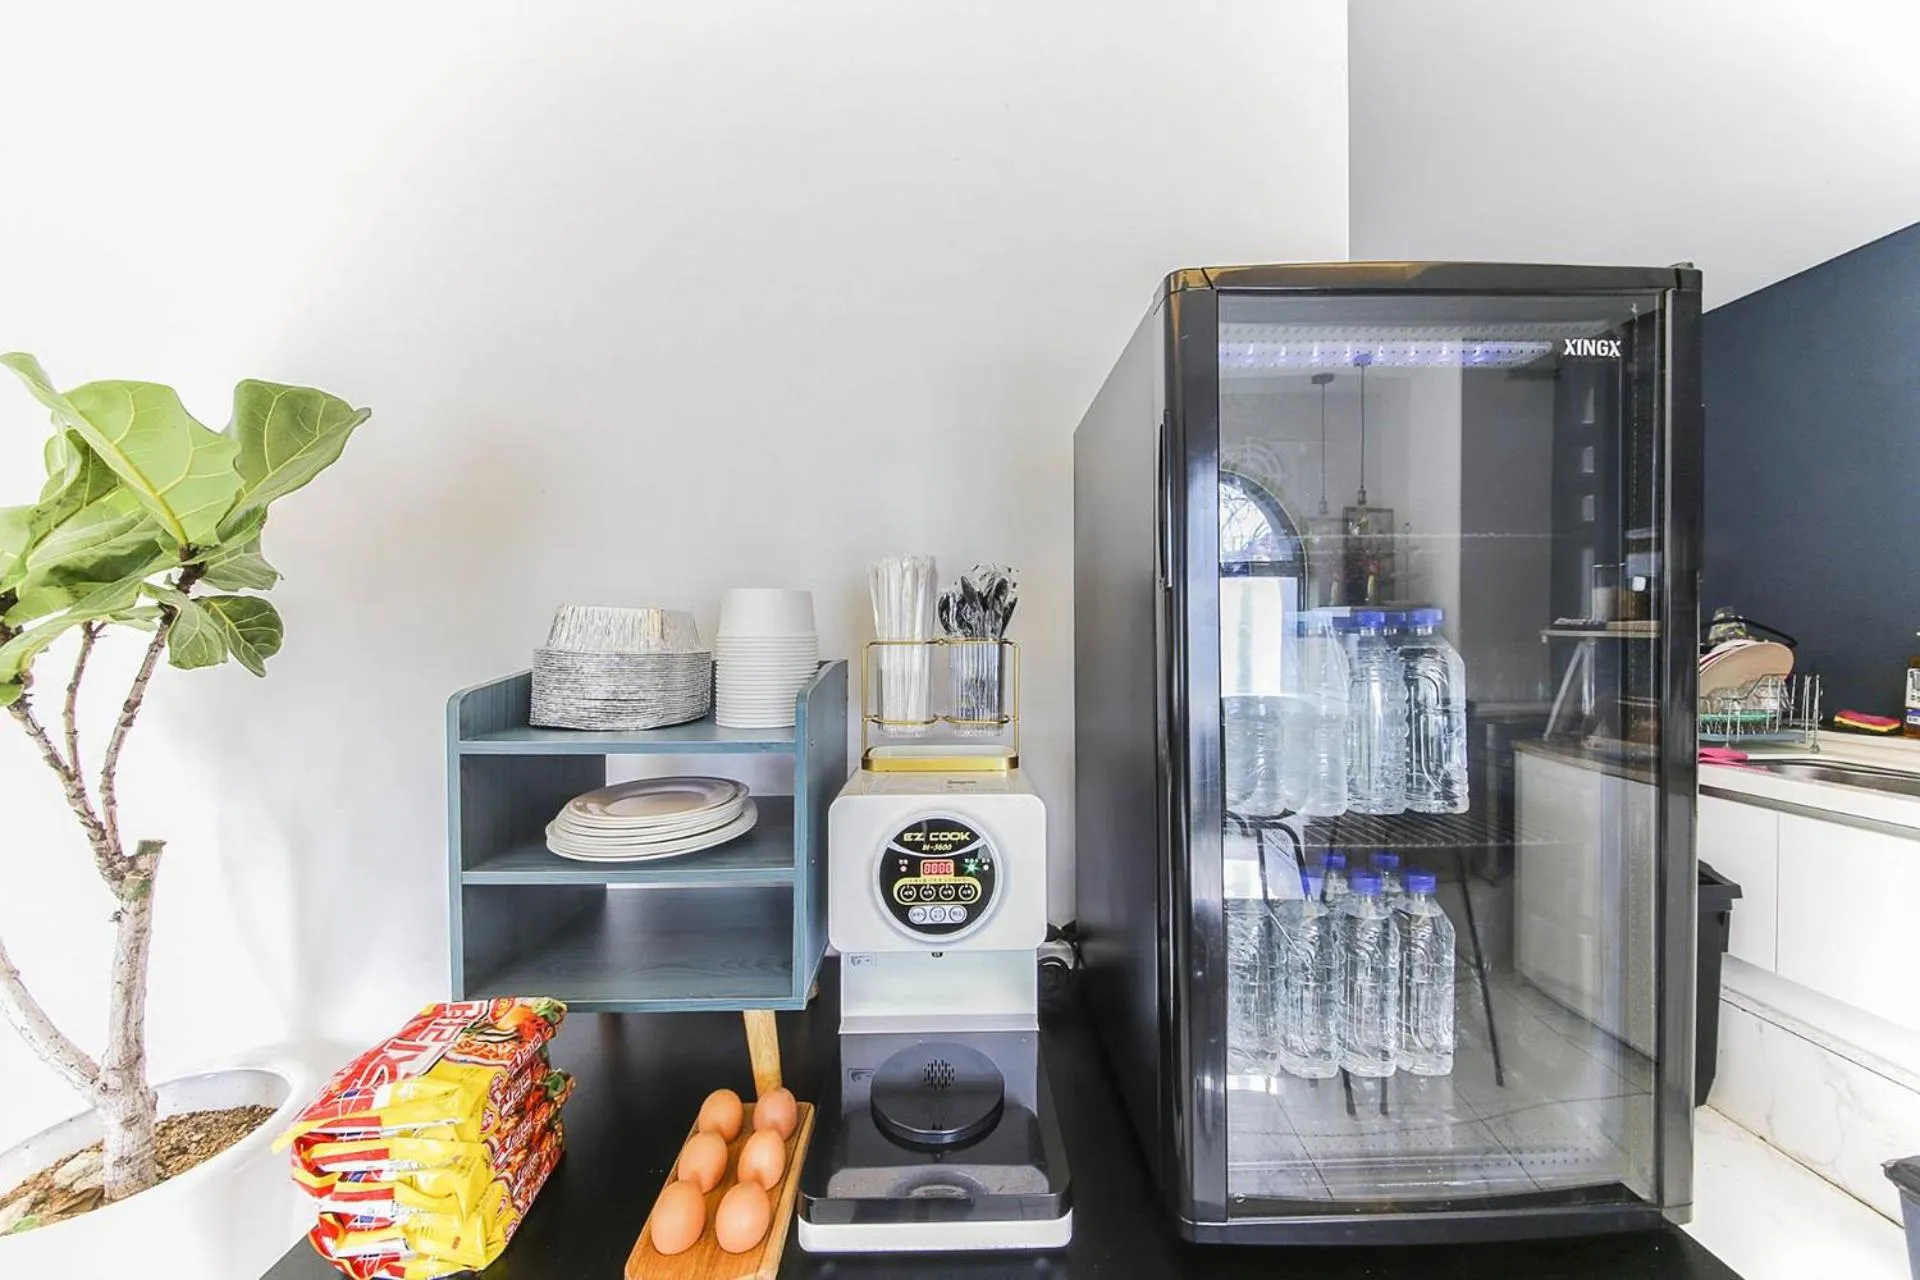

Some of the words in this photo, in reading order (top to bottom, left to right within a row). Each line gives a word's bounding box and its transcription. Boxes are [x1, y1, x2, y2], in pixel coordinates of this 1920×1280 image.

[1563, 338, 1621, 357] XINGX
[903, 832, 924, 841] EZ
[929, 832, 970, 841] COOK
